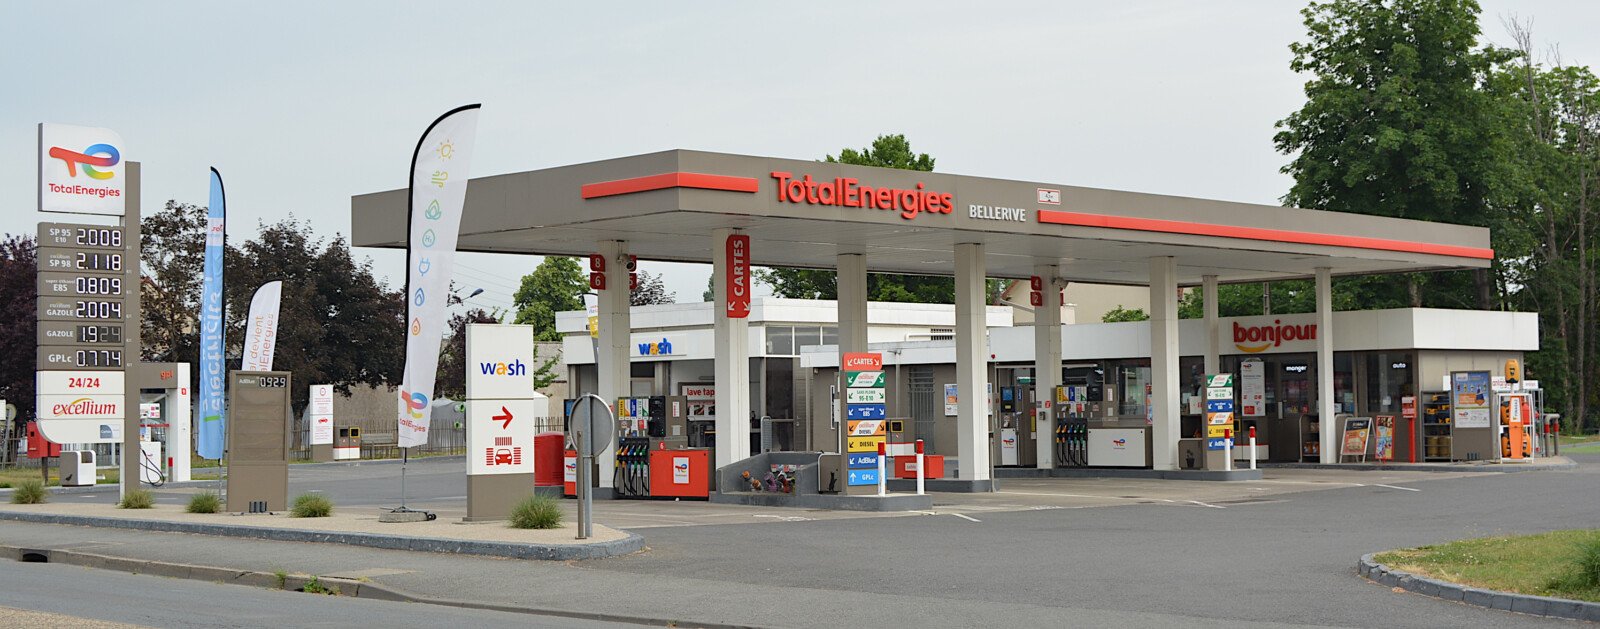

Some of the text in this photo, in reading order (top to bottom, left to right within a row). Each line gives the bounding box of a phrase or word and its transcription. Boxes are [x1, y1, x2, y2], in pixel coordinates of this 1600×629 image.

[48, 183, 120, 198] TotalEnergies
[770, 172, 953, 219] TotalEnergies
[968, 204, 1026, 222] BELLERIVE
[61, 229, 71, 237] 95
[77, 229, 121, 247] 2.008
[77, 253, 121, 271] 2.118
[595, 258, 600, 268] 8
[734, 239, 744, 296] CARTES
[76, 277, 121, 294] 0.809
[595, 276, 600, 286] 6
[1034, 294, 1039, 303] 2
[76, 301, 121, 318] 2.004
[82, 326, 120, 342] 1.924
[249, 315, 263, 358] devient
[1233, 320, 1317, 347] bonjour
[638, 338, 672, 356] wash
[48, 354, 72, 363] GPLc
[76, 351, 121, 367] 0.774
[480, 359, 525, 376] wash
[68, 378, 100, 388] 24/24
[53, 401, 116, 415] excellium
